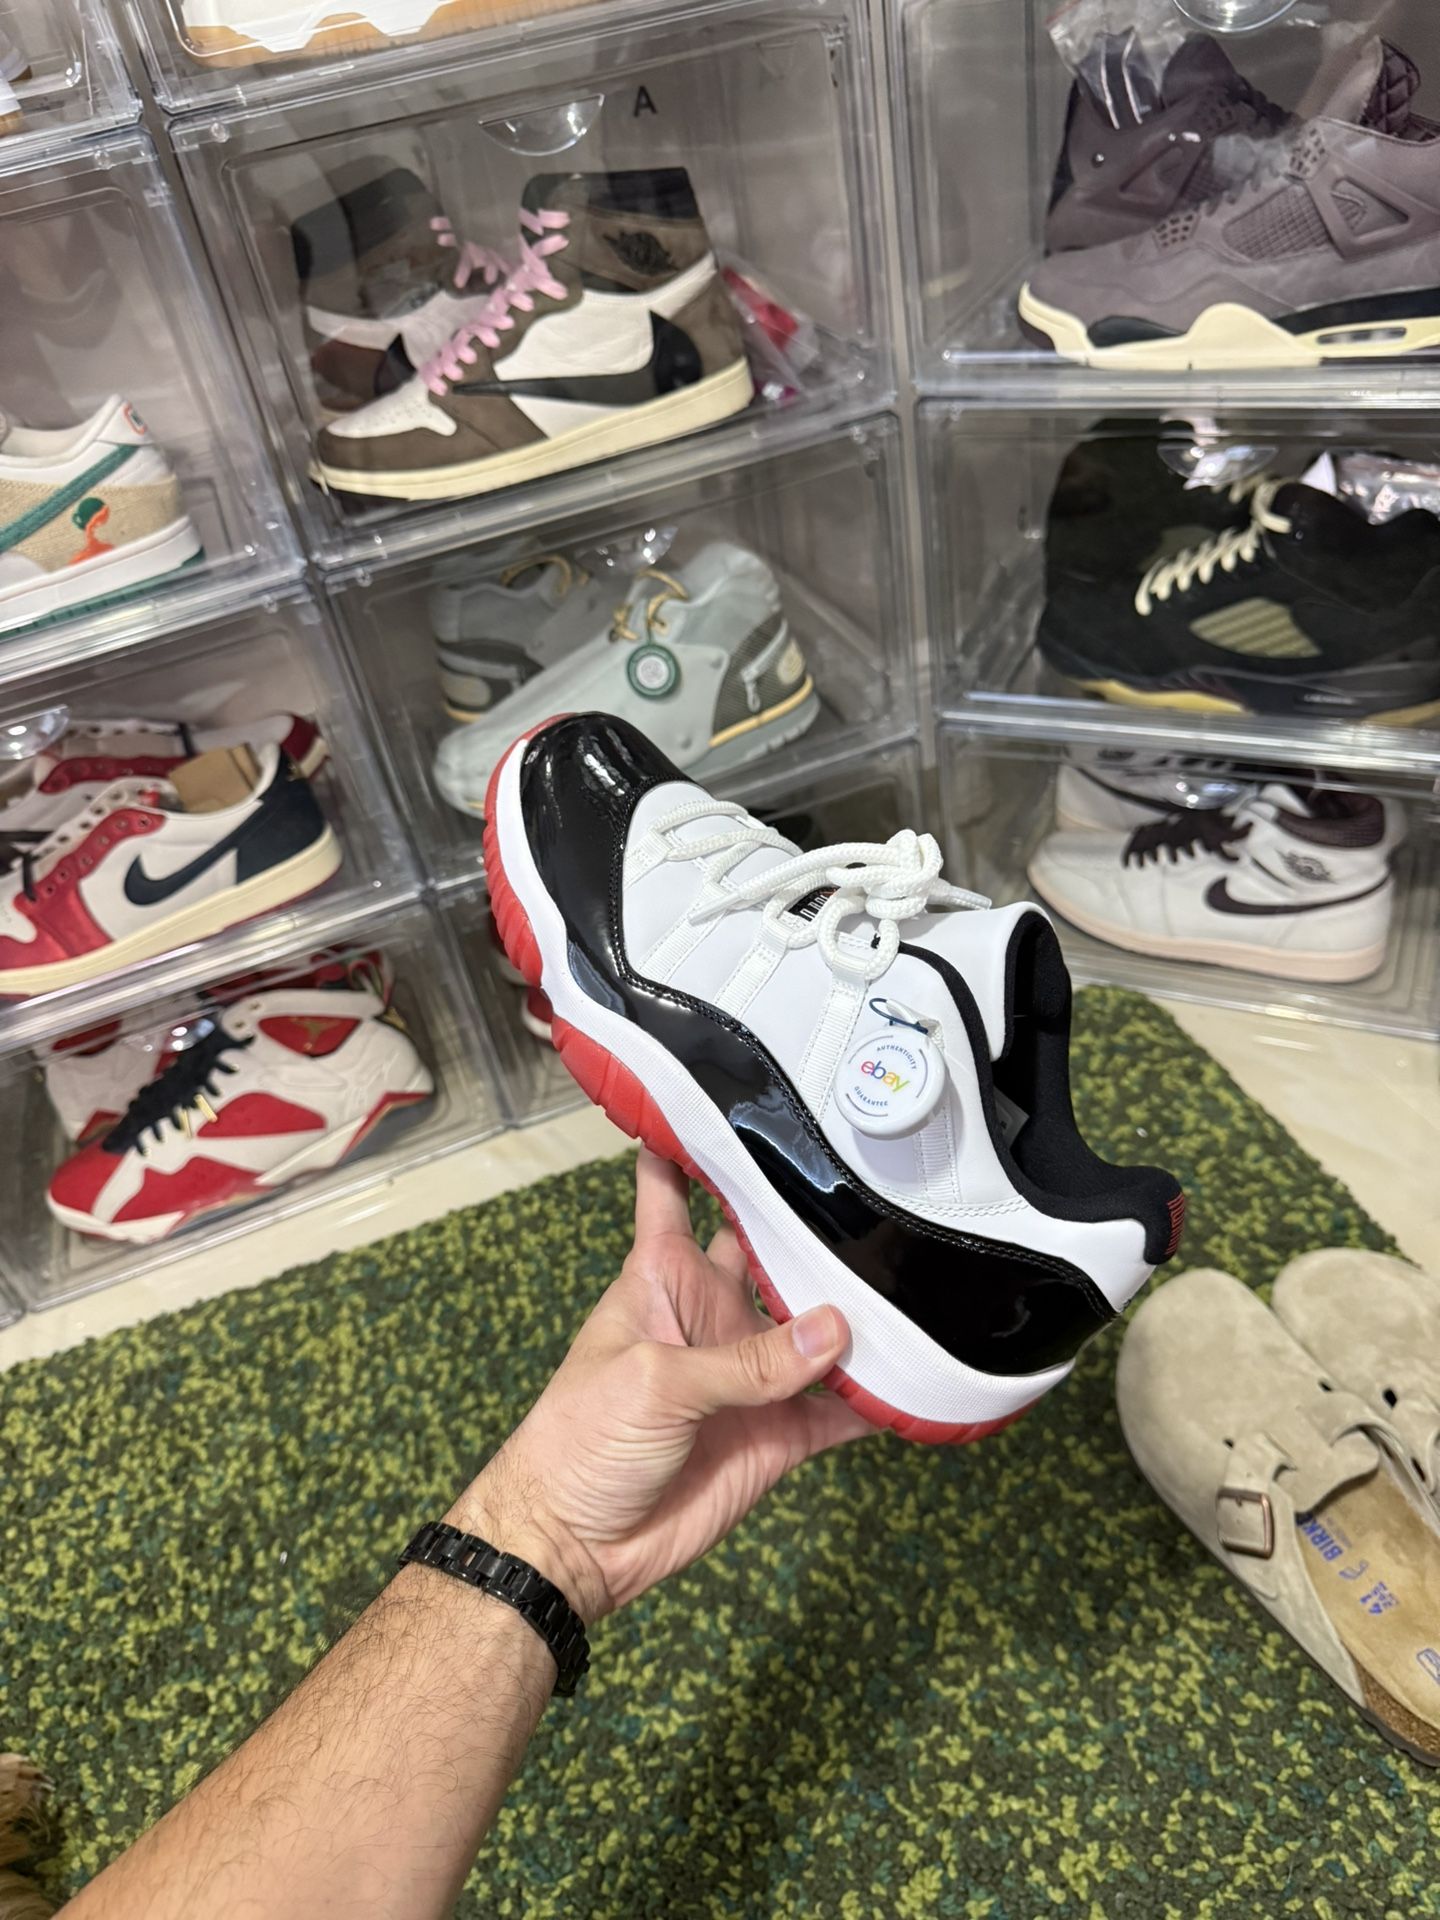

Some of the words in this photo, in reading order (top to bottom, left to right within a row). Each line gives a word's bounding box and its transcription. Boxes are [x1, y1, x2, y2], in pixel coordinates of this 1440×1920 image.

[633, 85, 658, 118] A
[877, 1044, 917, 1070] AUTHENTICITY
[861, 1060, 911, 1093] ebay
[854, 1085, 889, 1107] GUARANTEE
